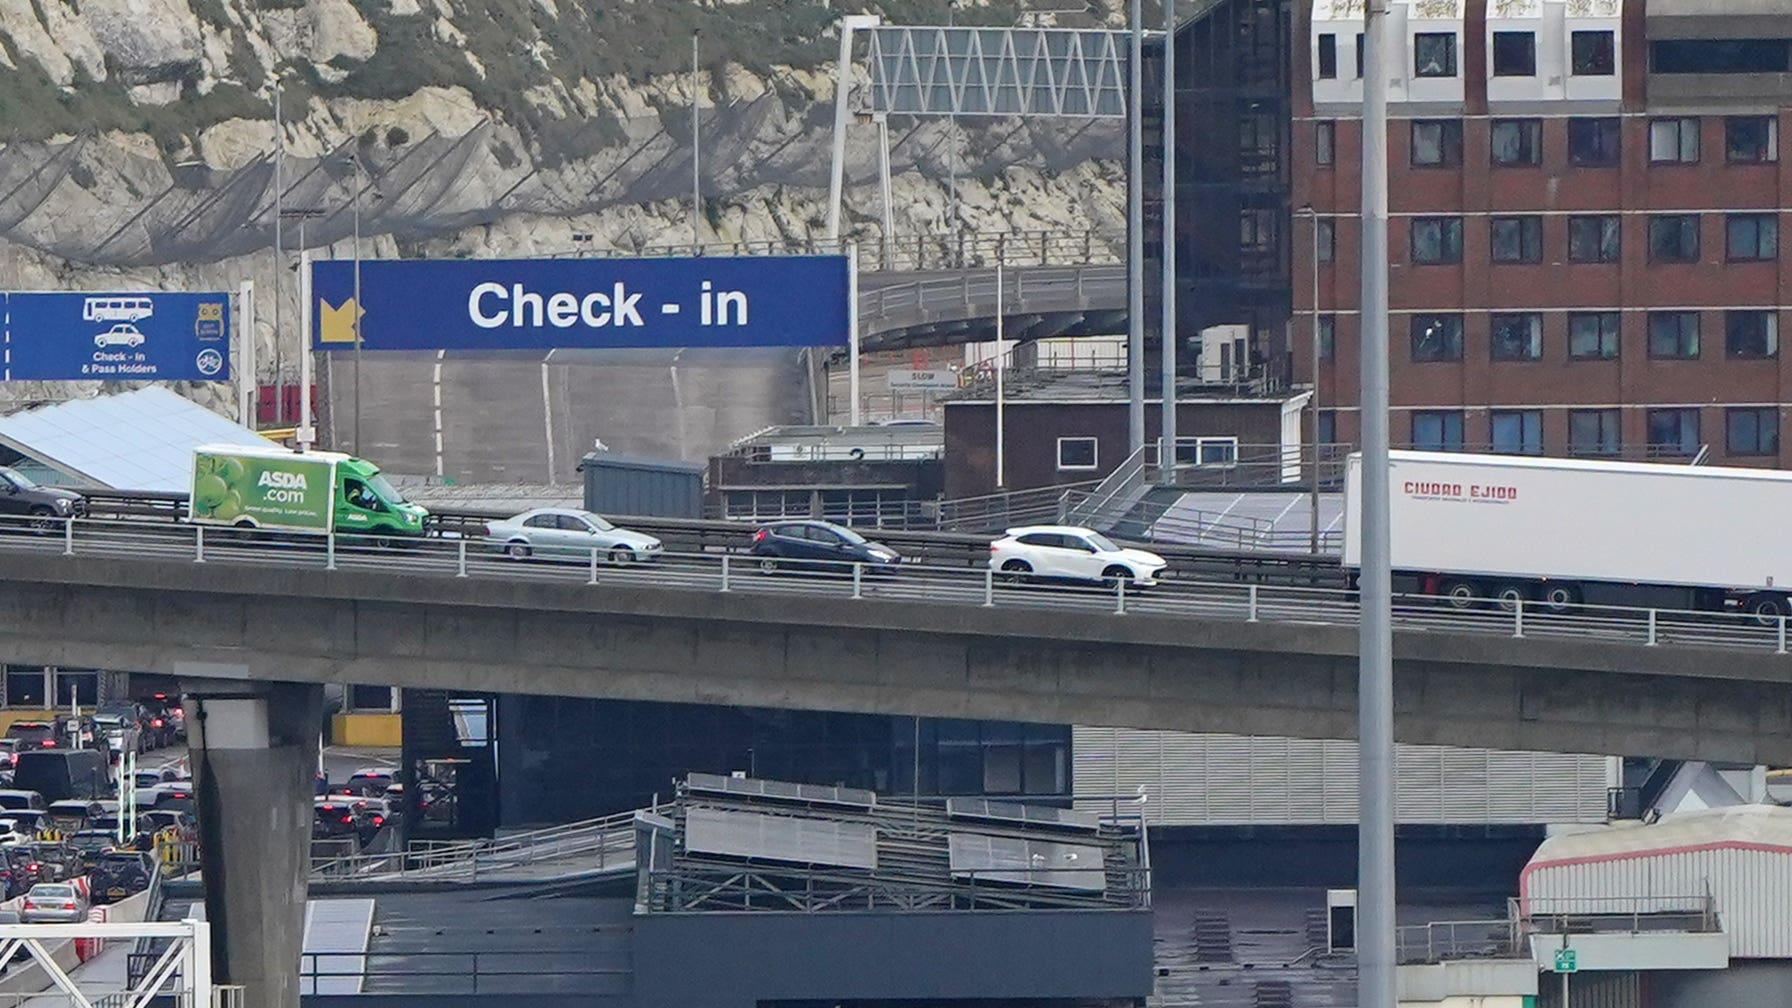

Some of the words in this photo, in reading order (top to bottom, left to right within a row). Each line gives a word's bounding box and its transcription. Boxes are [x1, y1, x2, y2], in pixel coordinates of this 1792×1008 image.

[468, 281, 644, 329] Check
[700, 280, 748, 326] in
[92, 351, 126, 362] Check
[134, 352, 146, 361] In
[81, 364, 90, 374] &
[91, 364, 117, 374] Pass
[118, 364, 157, 374] Holders
[911, 372, 936, 381] SLOW
[258, 470, 308, 490] ASDA
[262, 488, 305, 504] .com
[1404, 481, 1462, 497] CIUDAD
[1470, 485, 1517, 500] EJIDO
